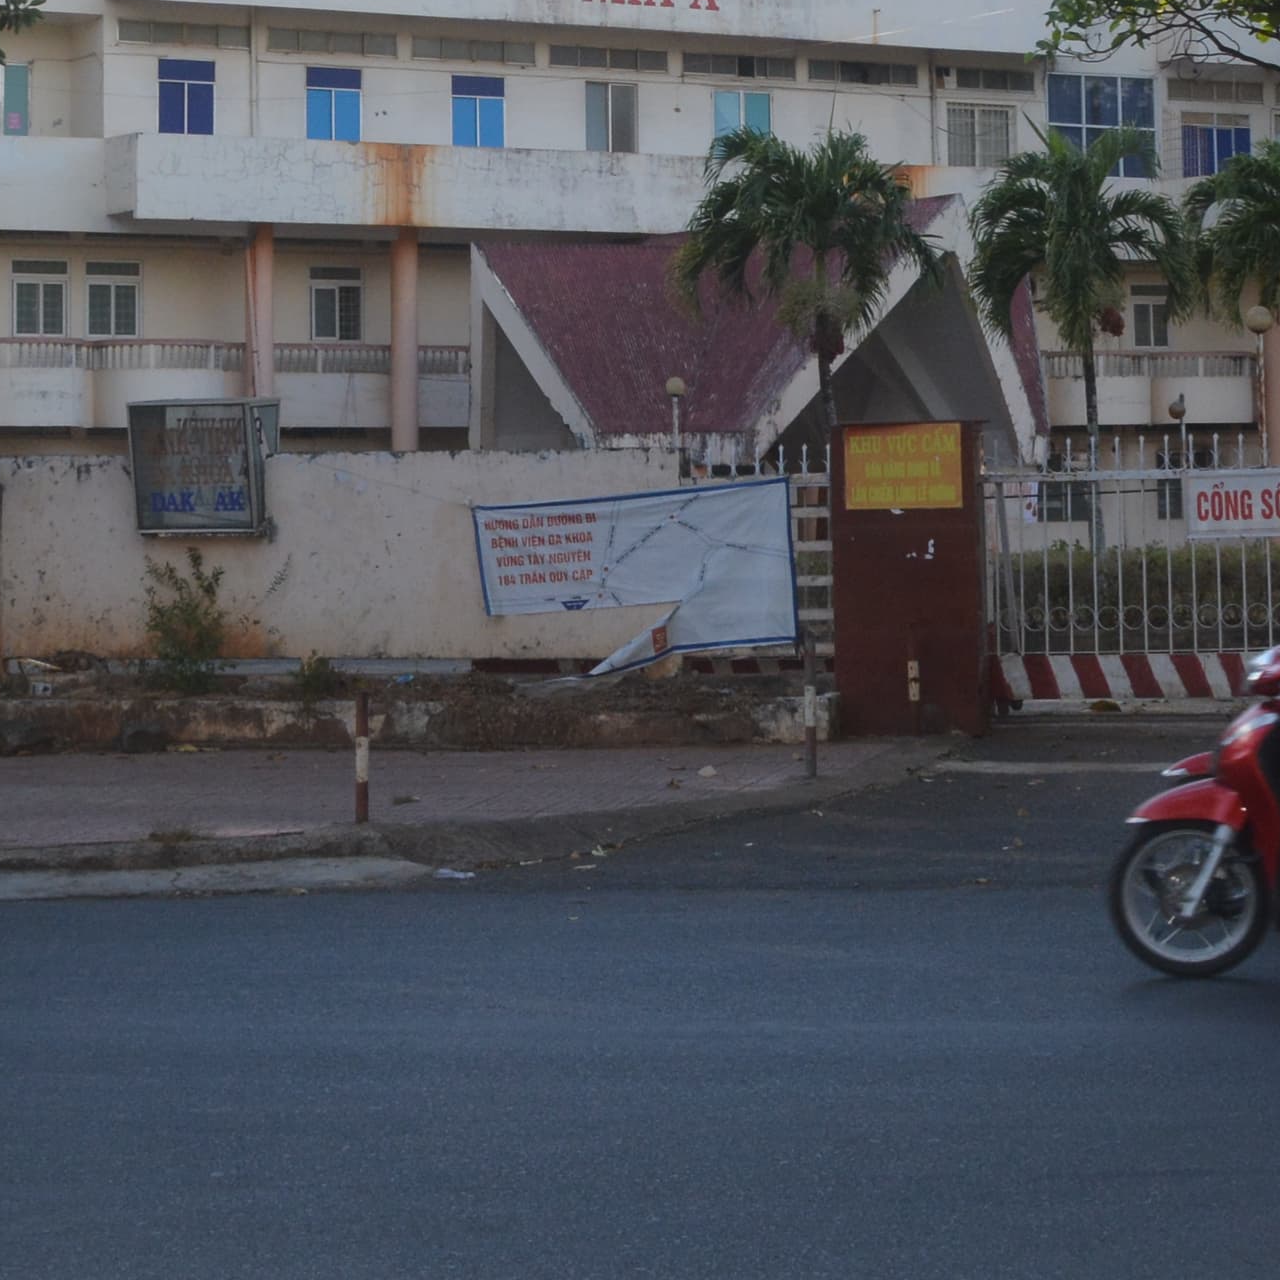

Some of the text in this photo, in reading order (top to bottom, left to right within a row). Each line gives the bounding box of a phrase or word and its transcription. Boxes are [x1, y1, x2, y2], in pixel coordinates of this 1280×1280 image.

[849, 434, 881, 454] KHU
[1196, 481, 1254, 522] CỔNG
[564, 531, 593, 544] KHOA
